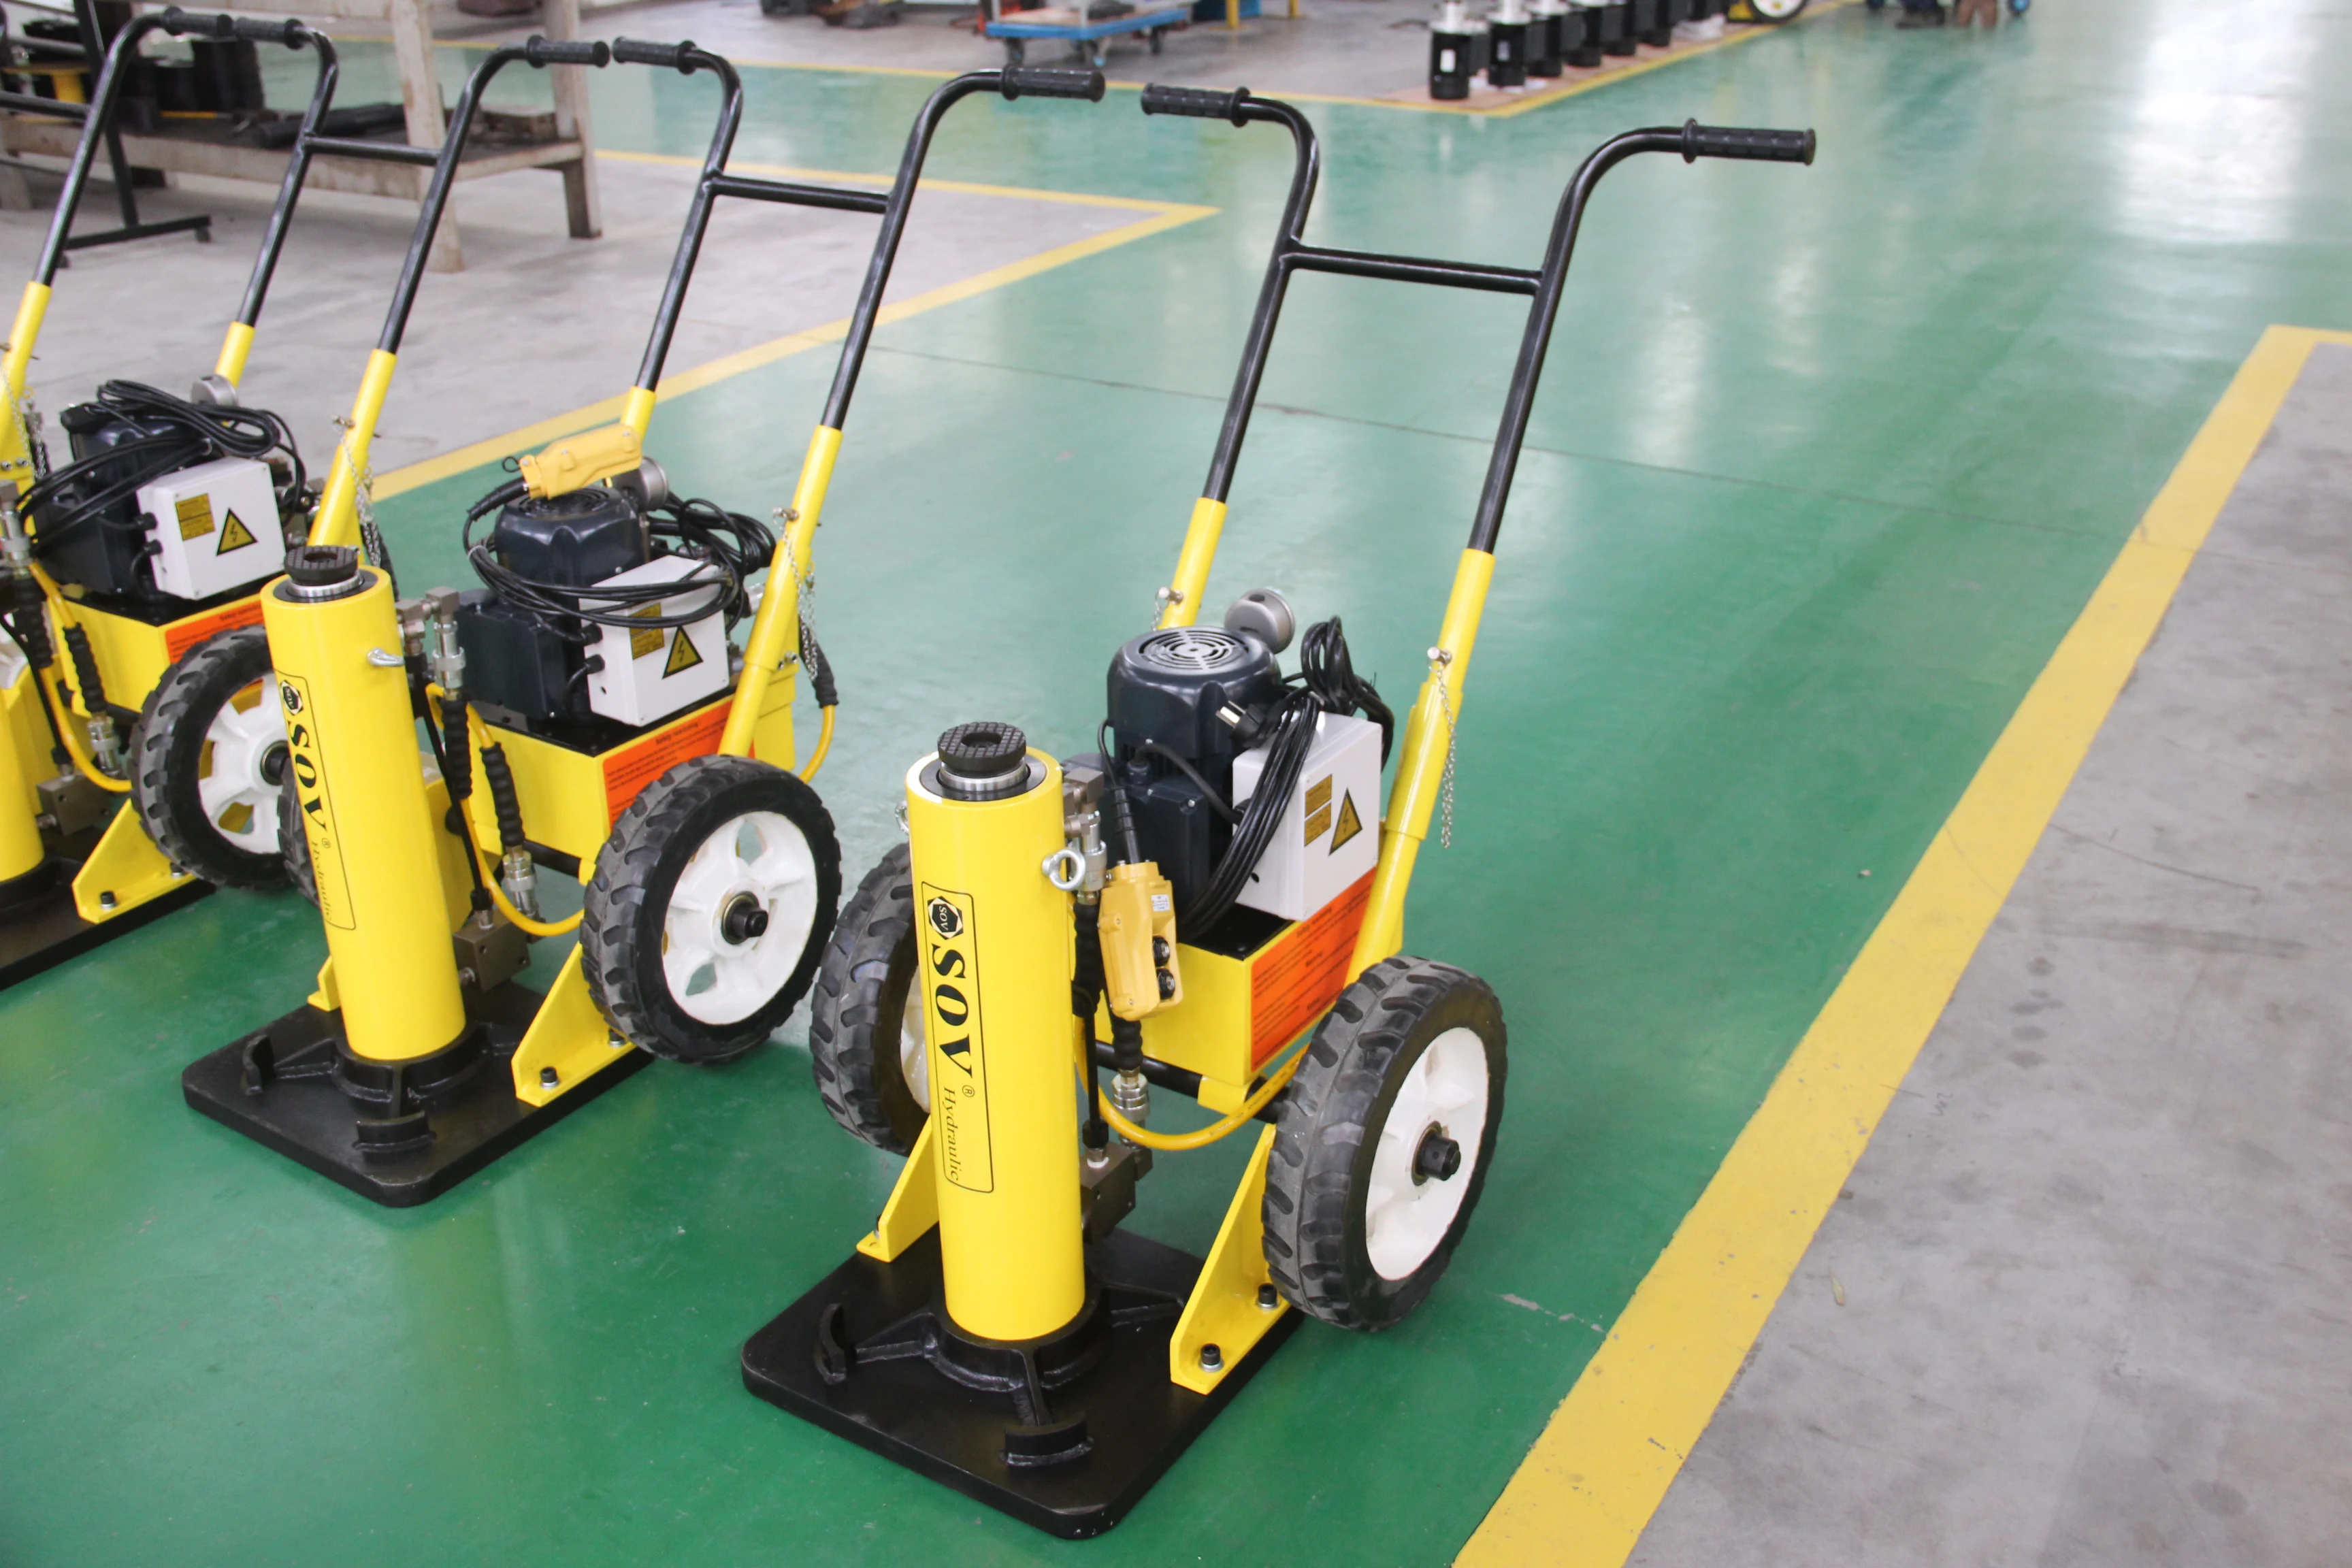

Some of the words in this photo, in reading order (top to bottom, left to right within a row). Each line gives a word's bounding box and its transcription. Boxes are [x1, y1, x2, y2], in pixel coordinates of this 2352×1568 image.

[287, 720, 327, 831] SOV
[938, 906, 949, 930] SOV
[931, 943, 973, 1079] SOV
[943, 1085, 963, 1181] Hydraulic
